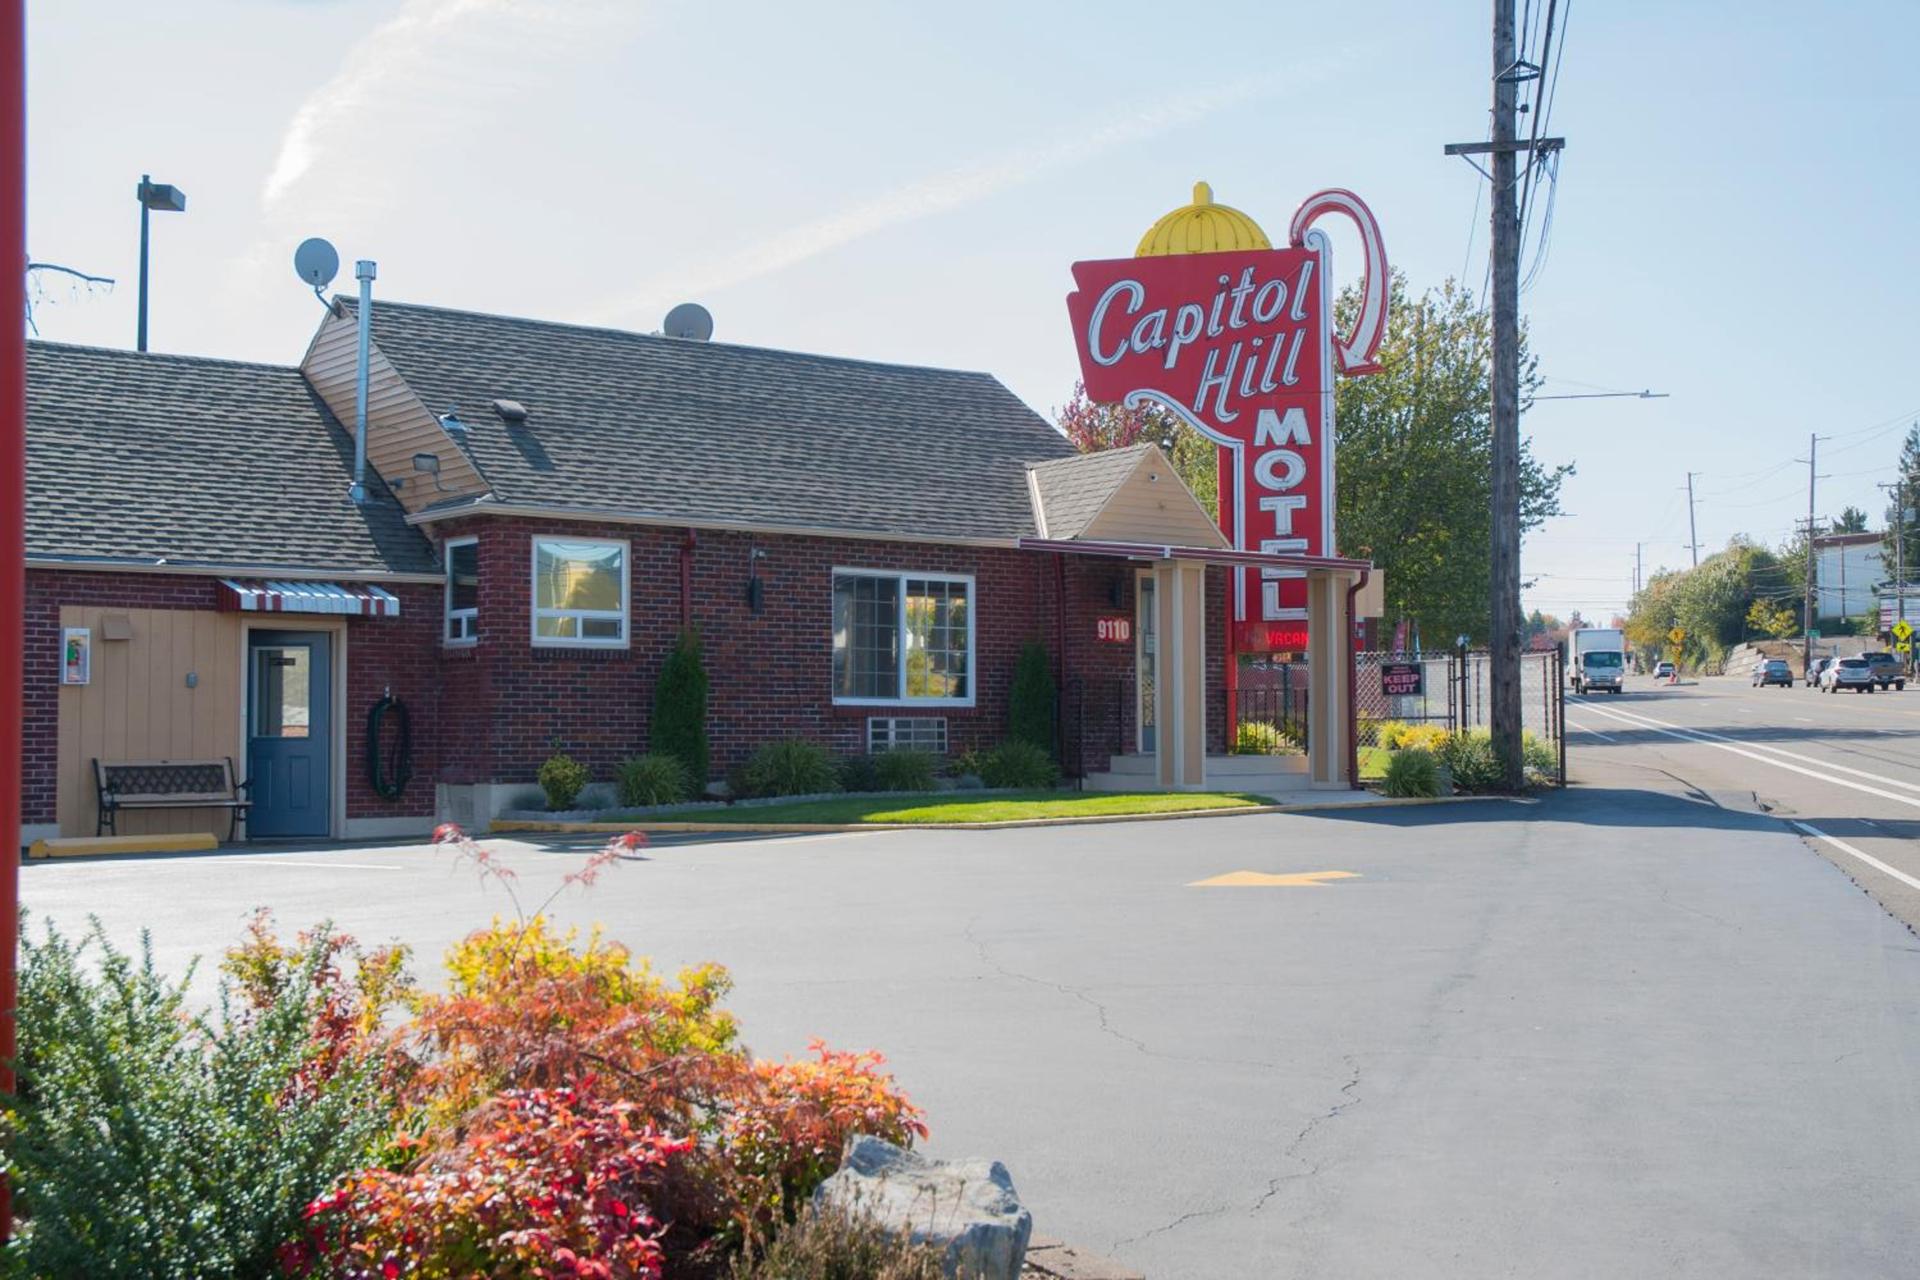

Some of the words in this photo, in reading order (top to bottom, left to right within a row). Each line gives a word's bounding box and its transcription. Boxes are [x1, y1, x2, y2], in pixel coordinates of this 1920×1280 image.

[1087, 259, 1315, 370] Capitol
[1193, 328, 1307, 423] Hill
[1253, 407, 1312, 621] MOTEL
[1097, 619, 1130, 640] 9110
[1383, 673, 1419, 684] KEEP
[1388, 683, 1415, 694] OUT
